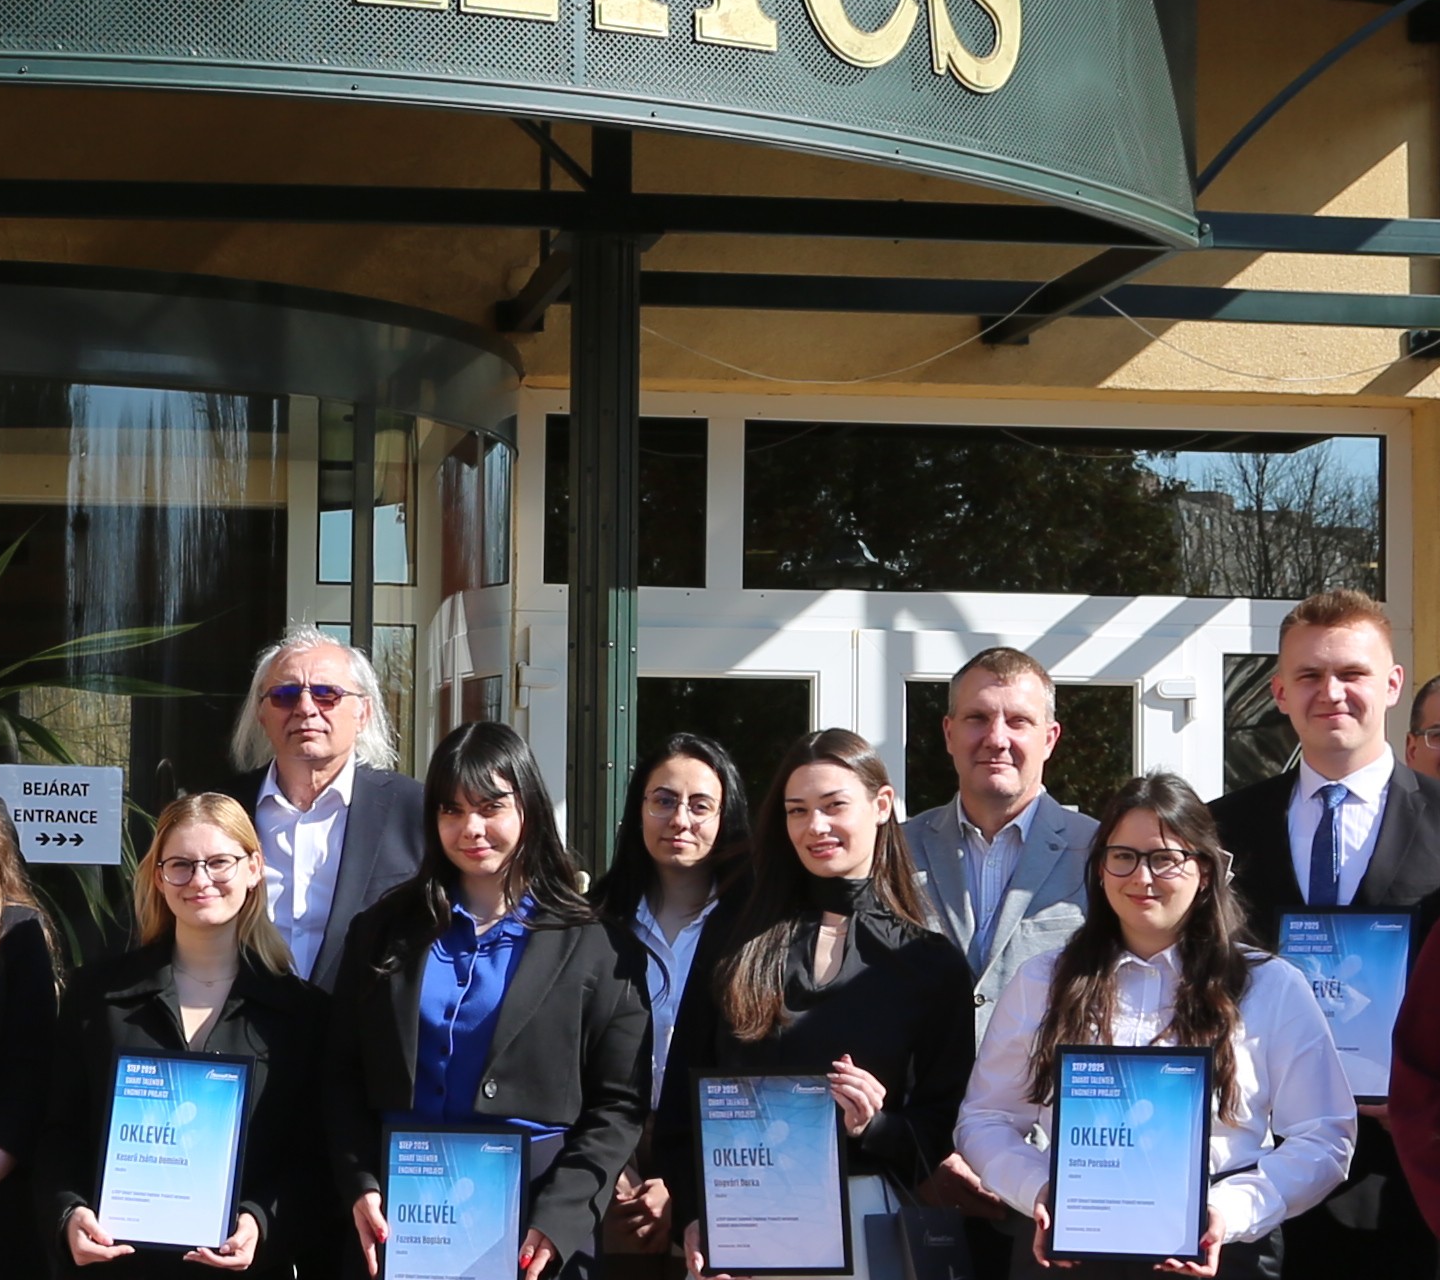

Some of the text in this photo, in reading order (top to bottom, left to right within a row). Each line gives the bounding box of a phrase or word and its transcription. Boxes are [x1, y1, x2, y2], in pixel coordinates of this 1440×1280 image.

[23, 779, 90, 797] BEJÁRAT
[14, 809, 98, 824] ENTRANCE
[1313, 976, 1344, 999] EVÉL
[1072, 1063, 1104, 1072] STEP 2025
[120, 1122, 177, 1145] OKLEVÉL
[1071, 1122, 1135, 1148] OKLEVÉL
[713, 1143, 774, 1167] OKLEVÉL
[397, 1200, 456, 1224] OKLEVÉL
